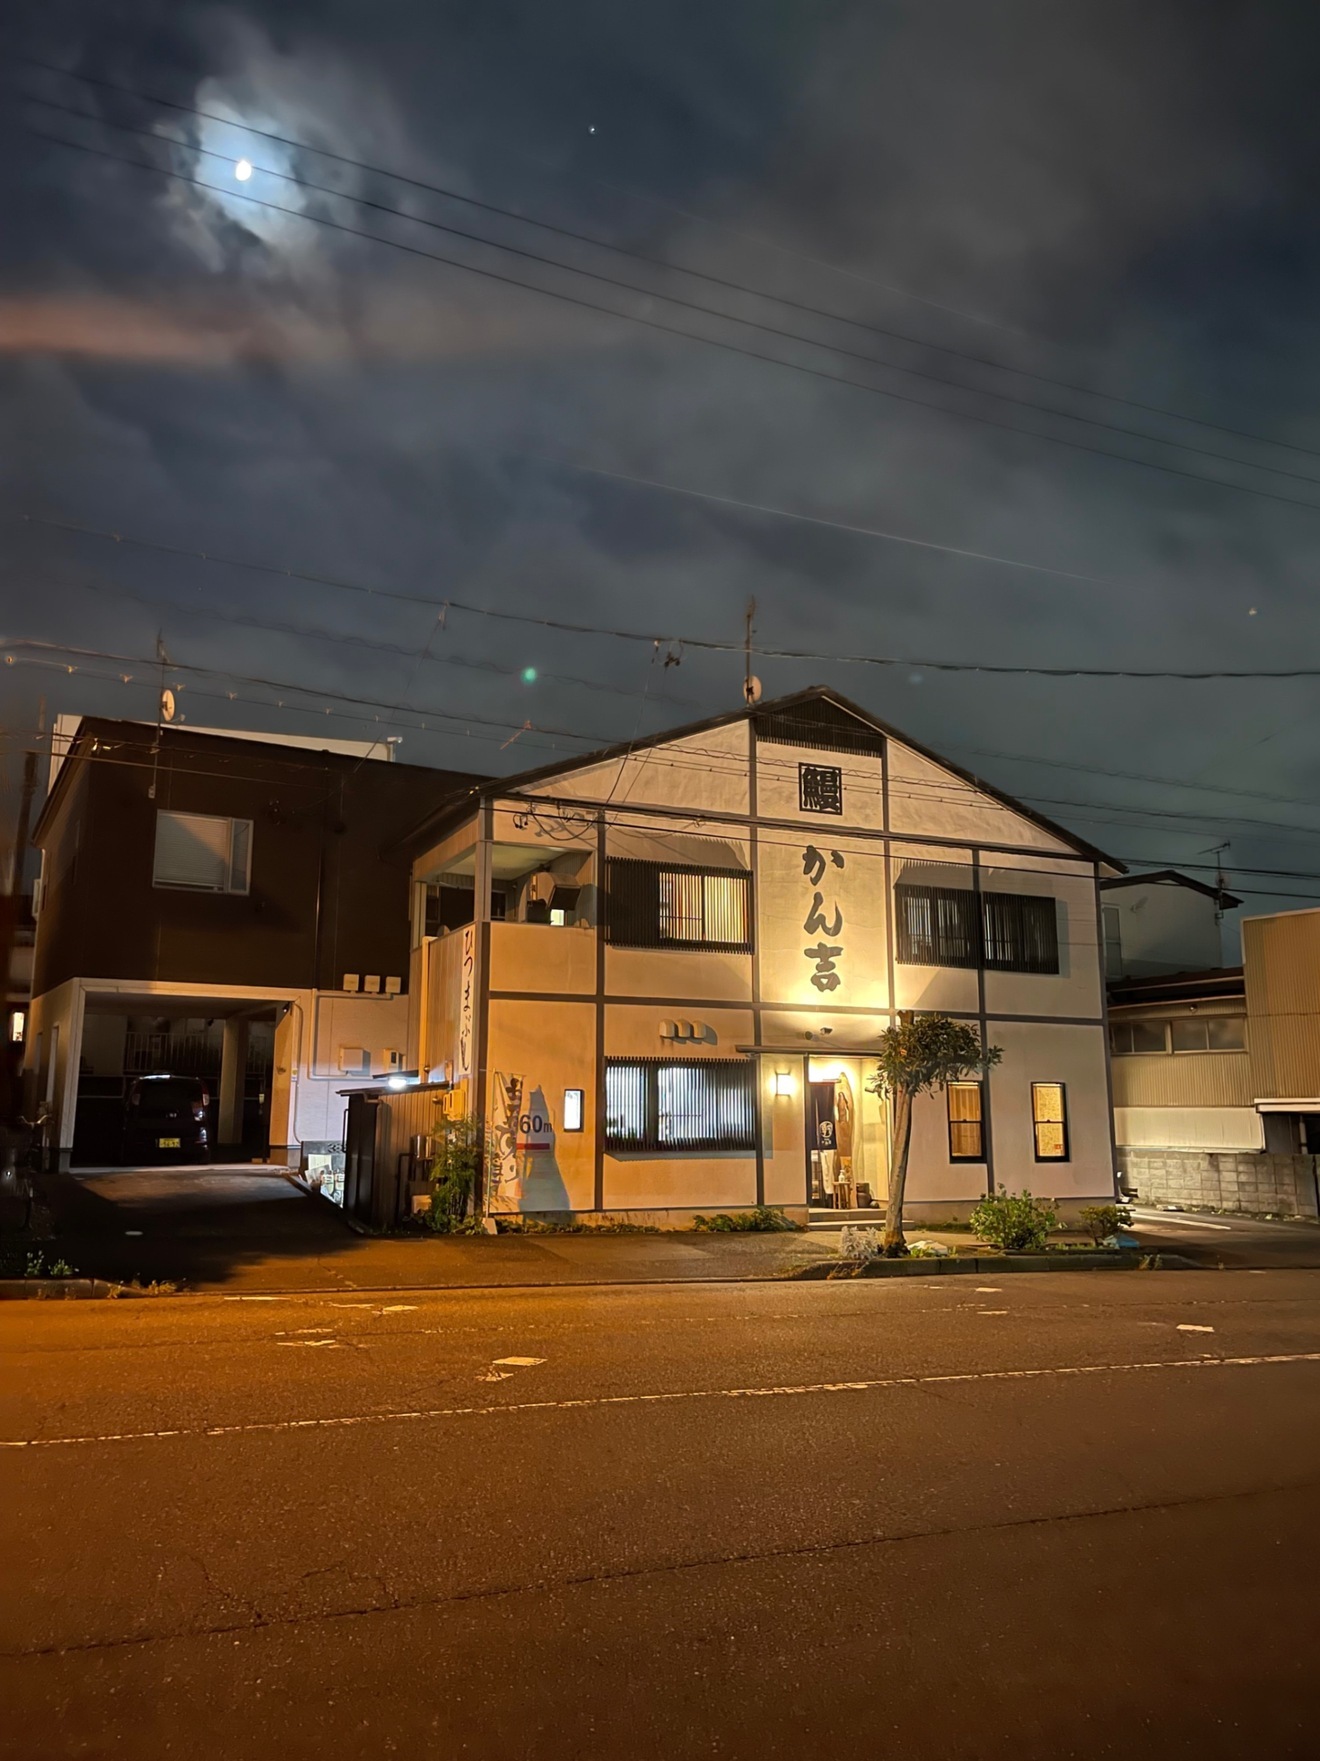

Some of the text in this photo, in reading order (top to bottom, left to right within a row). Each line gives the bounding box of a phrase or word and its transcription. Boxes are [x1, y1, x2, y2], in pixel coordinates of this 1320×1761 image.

[802, 844, 845, 992] かん吉
[460, 929, 474, 1072] ひつまぶし
